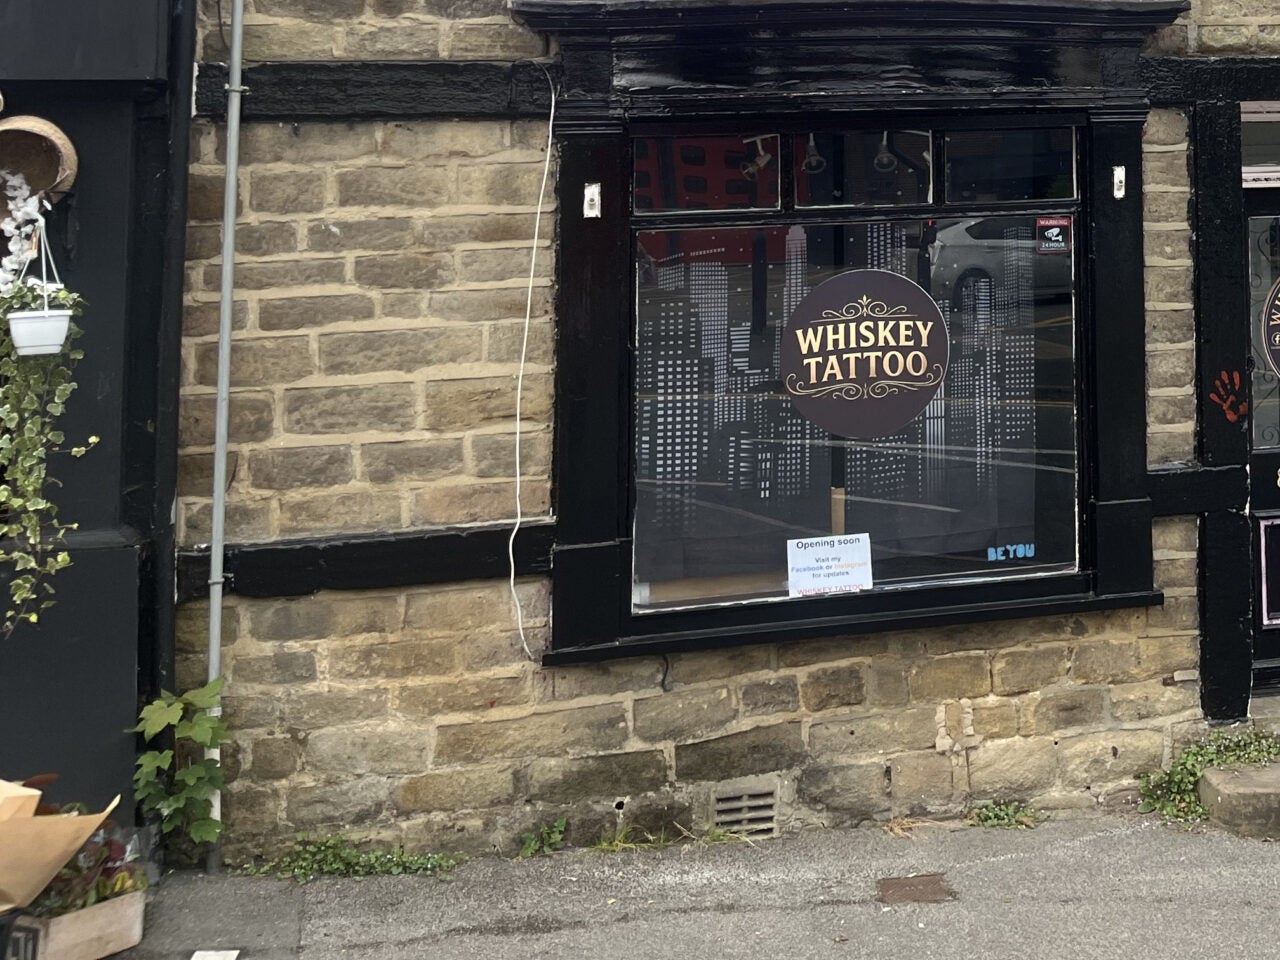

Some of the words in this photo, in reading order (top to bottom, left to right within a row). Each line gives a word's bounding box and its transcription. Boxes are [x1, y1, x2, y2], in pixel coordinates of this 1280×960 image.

[795, 320, 934, 355] WHISKEY
[803, 350, 928, 384] TATTOO
[796, 540, 835, 550] Opening
[837, 537, 861, 546] soon
[1006, 543, 1035, 559] YOU
